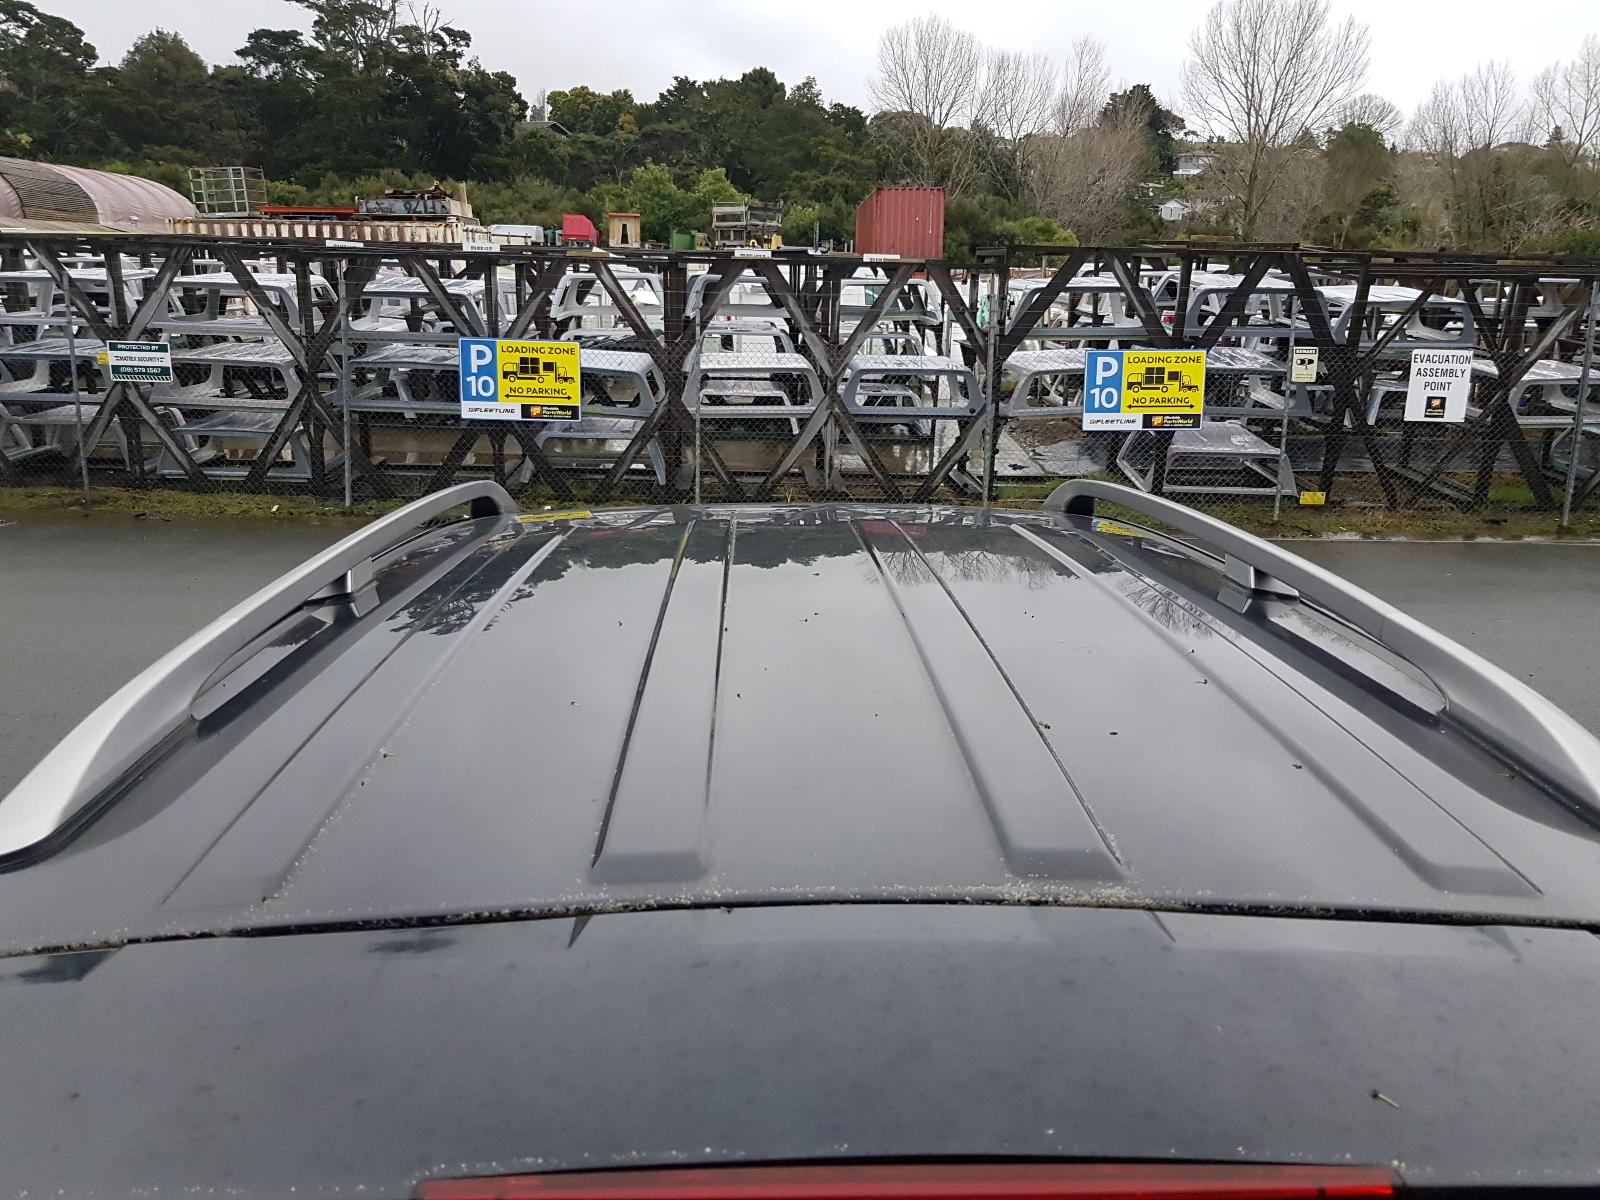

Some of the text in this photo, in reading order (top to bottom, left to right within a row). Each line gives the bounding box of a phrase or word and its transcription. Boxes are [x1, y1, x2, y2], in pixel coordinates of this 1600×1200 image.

[501, 345, 576, 355] LOADING ZONE
[470, 344, 493, 373] P
[1127, 356, 1202, 364] LOADING ZONE
[1413, 353, 1471, 364] EVACUATION
[1095, 356, 1119, 385] P
[1415, 367, 1466, 378] ASSEMBLY
[466, 375, 495, 397] 10
[509, 386, 568, 395] NO PARKING
[1423, 381, 1452, 391] POINT
[1090, 387, 1118, 409] 10
[1132, 396, 1190, 405] NO PARKING
